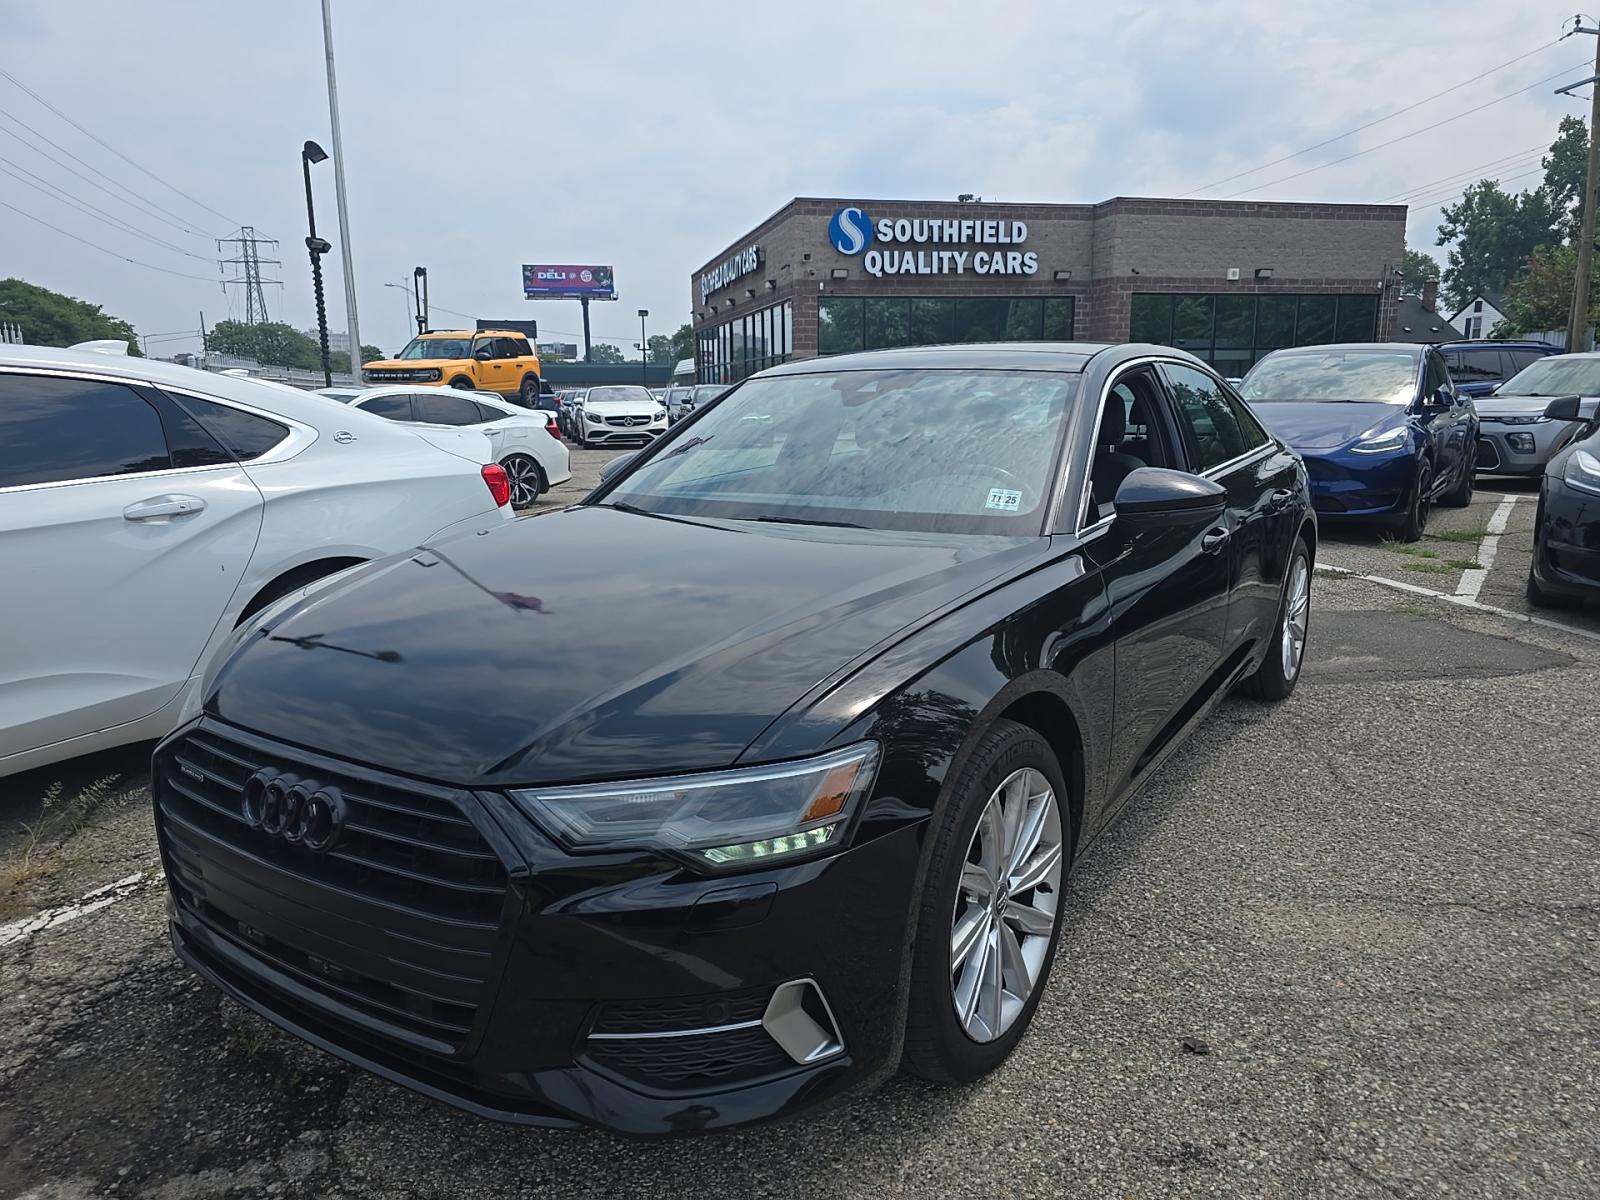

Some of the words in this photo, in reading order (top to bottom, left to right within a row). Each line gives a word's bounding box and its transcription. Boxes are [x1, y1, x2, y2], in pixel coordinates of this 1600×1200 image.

[877, 218, 1028, 244] SOUTHFIELD
[864, 250, 968, 278] QUALITY
[973, 251, 1038, 275] CARS
[537, 272, 566, 280] DELI
[1004, 495, 1018, 505] 25
